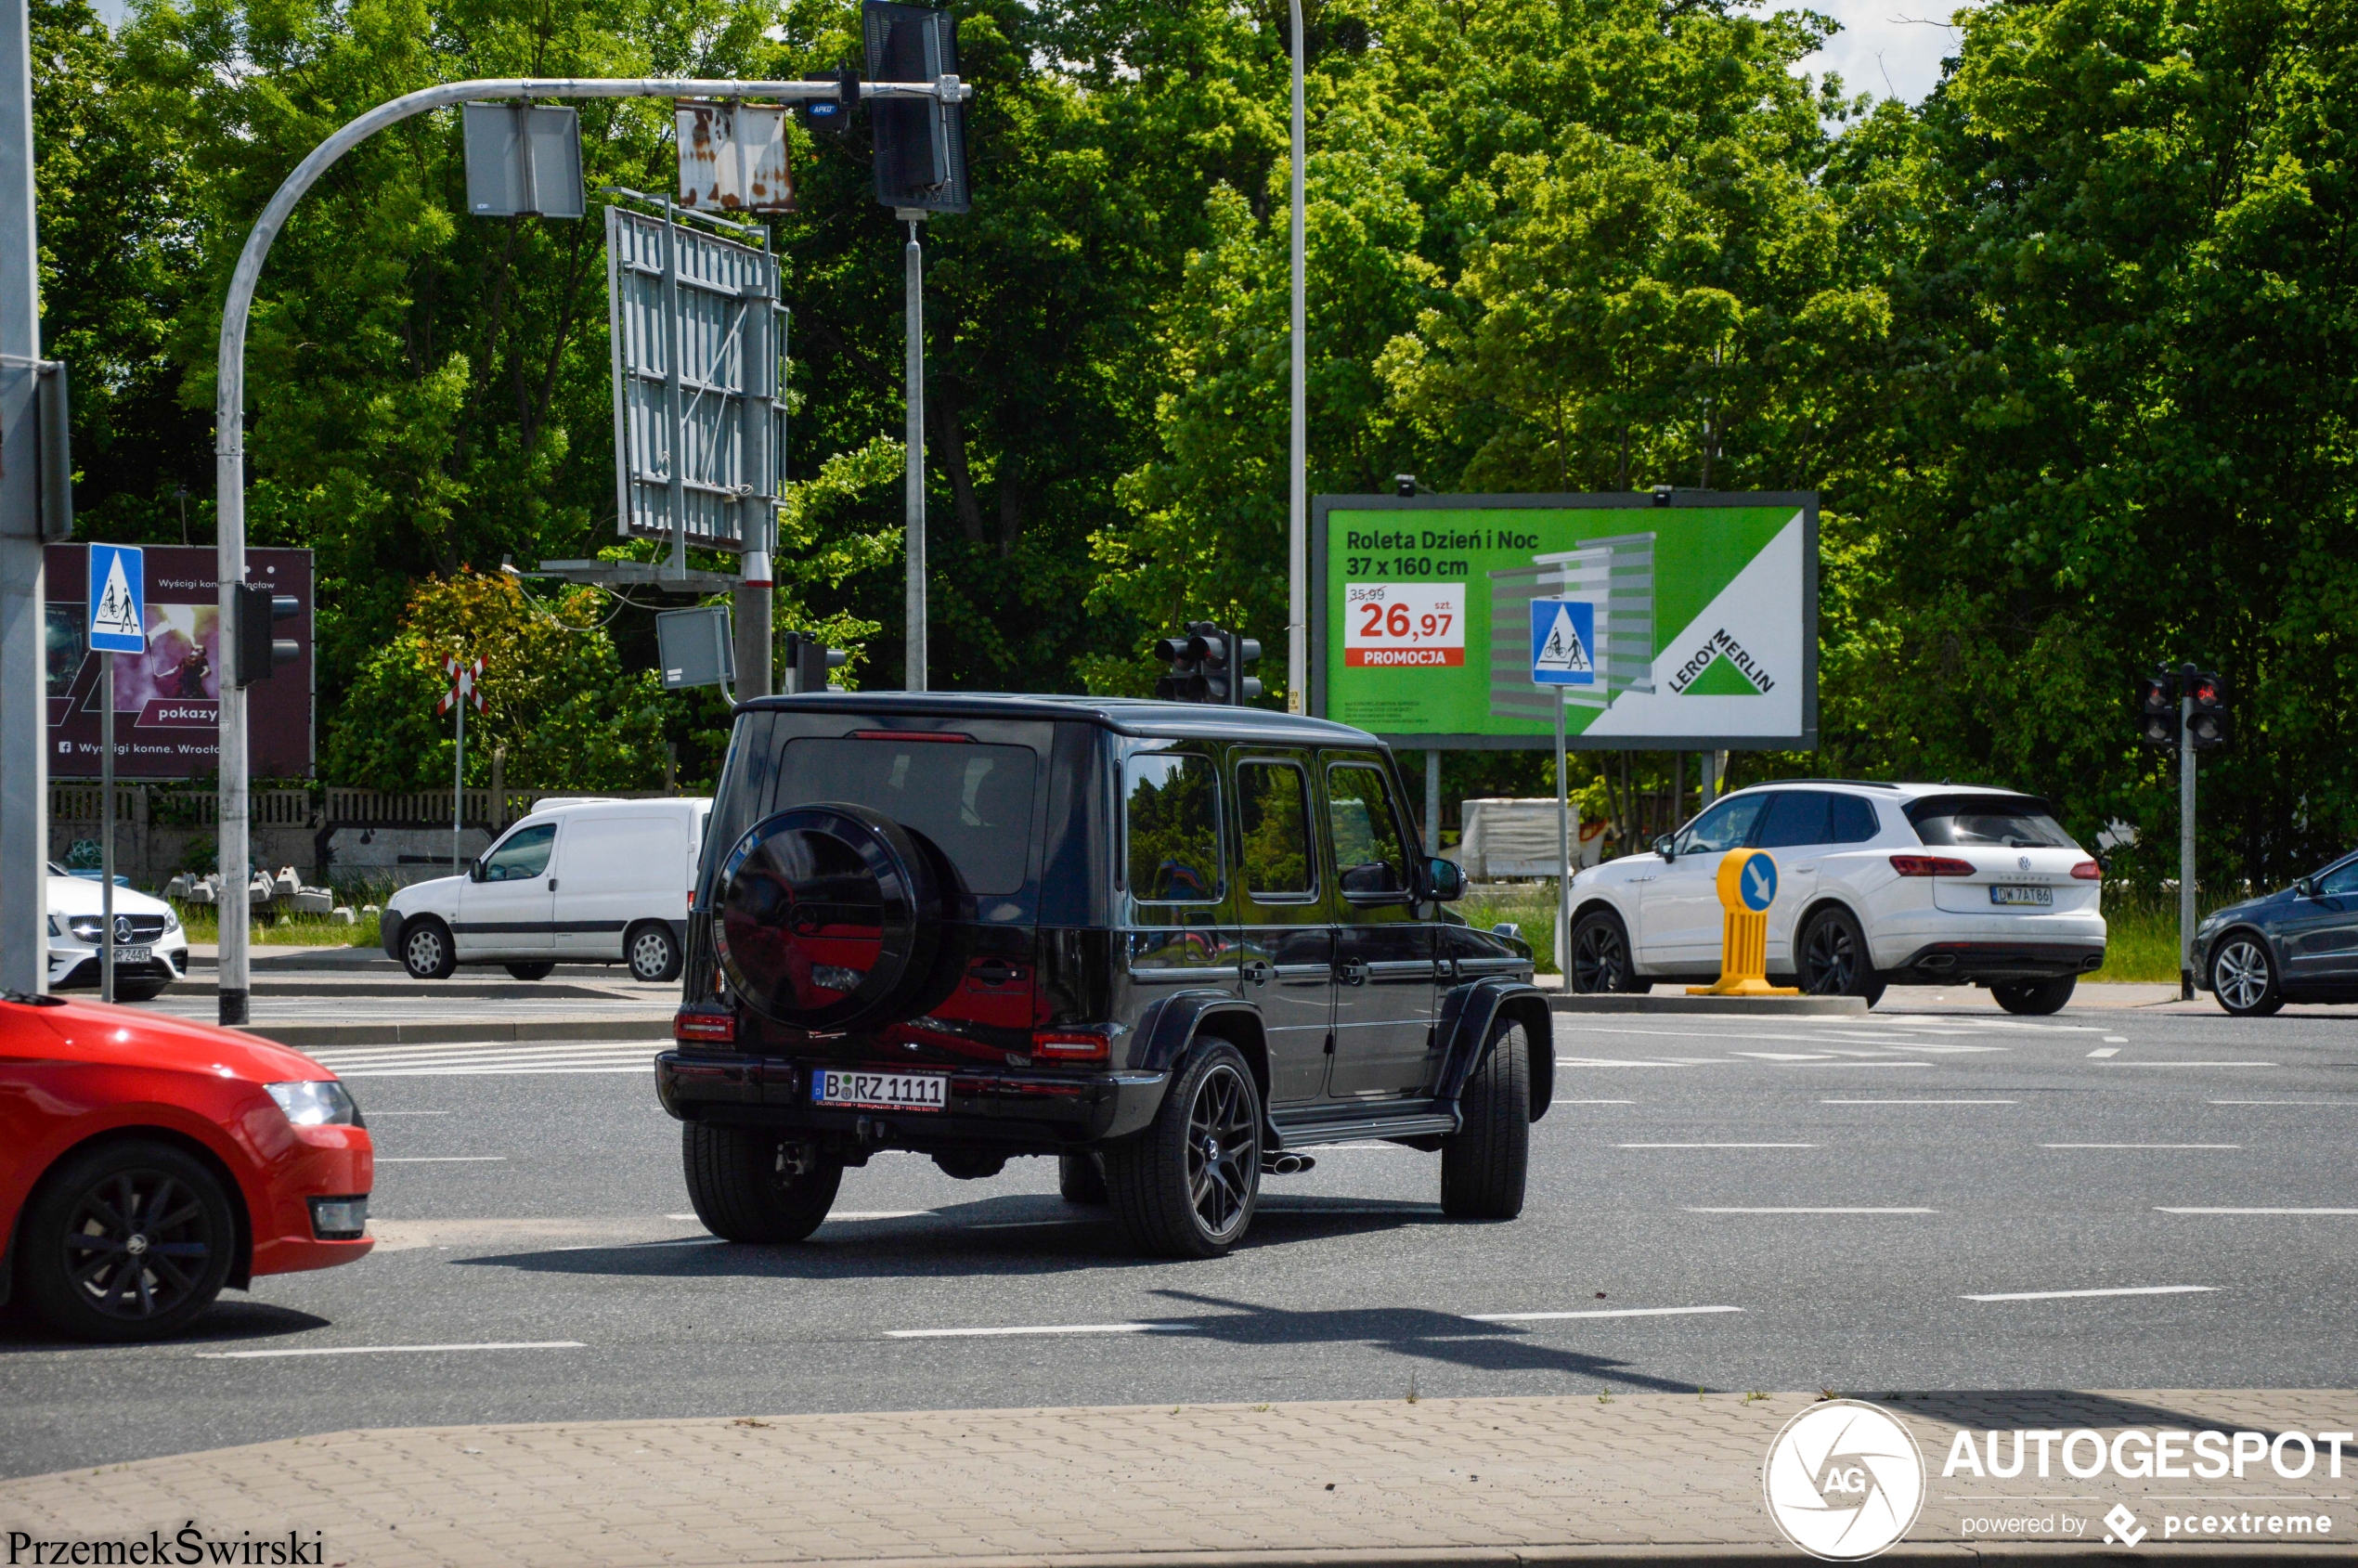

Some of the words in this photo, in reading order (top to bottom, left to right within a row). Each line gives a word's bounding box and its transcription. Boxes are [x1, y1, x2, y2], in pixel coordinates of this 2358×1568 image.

[1347, 531, 1416, 550] Roleta
[1422, 530, 1482, 550] Dzień
[1486, 531, 1492, 550] i
[1498, 531, 1539, 550] Noc
[1347, 558, 1372, 576] 37
[1376, 561, 1389, 576] x
[1393, 557, 1432, 576] 160
[1436, 561, 1469, 576] cm
[158, 579, 197, 590] Wyścigi
[200, 579, 219, 589] kon
[1350, 589, 1385, 602] 35,99
[1435, 602, 1453, 610] szt.
[1360, 603, 1453, 642] 26,97
[1364, 651, 1446, 665] PROMOCJA
[1668, 639, 1717, 693] LEROY
[1713, 628, 1775, 693] MERLIN
[159, 707, 218, 721] pokazy
[79, 743, 129, 755] Wyigi
[134, 744, 174, 754] konne.
[1999, 888, 2014, 901] DW
[2016, 888, 2050, 901] 7AT86
[825, 1074, 839, 1097] B
[854, 1076, 883, 1100] RZ
[887, 1078, 941, 1104] 1111
